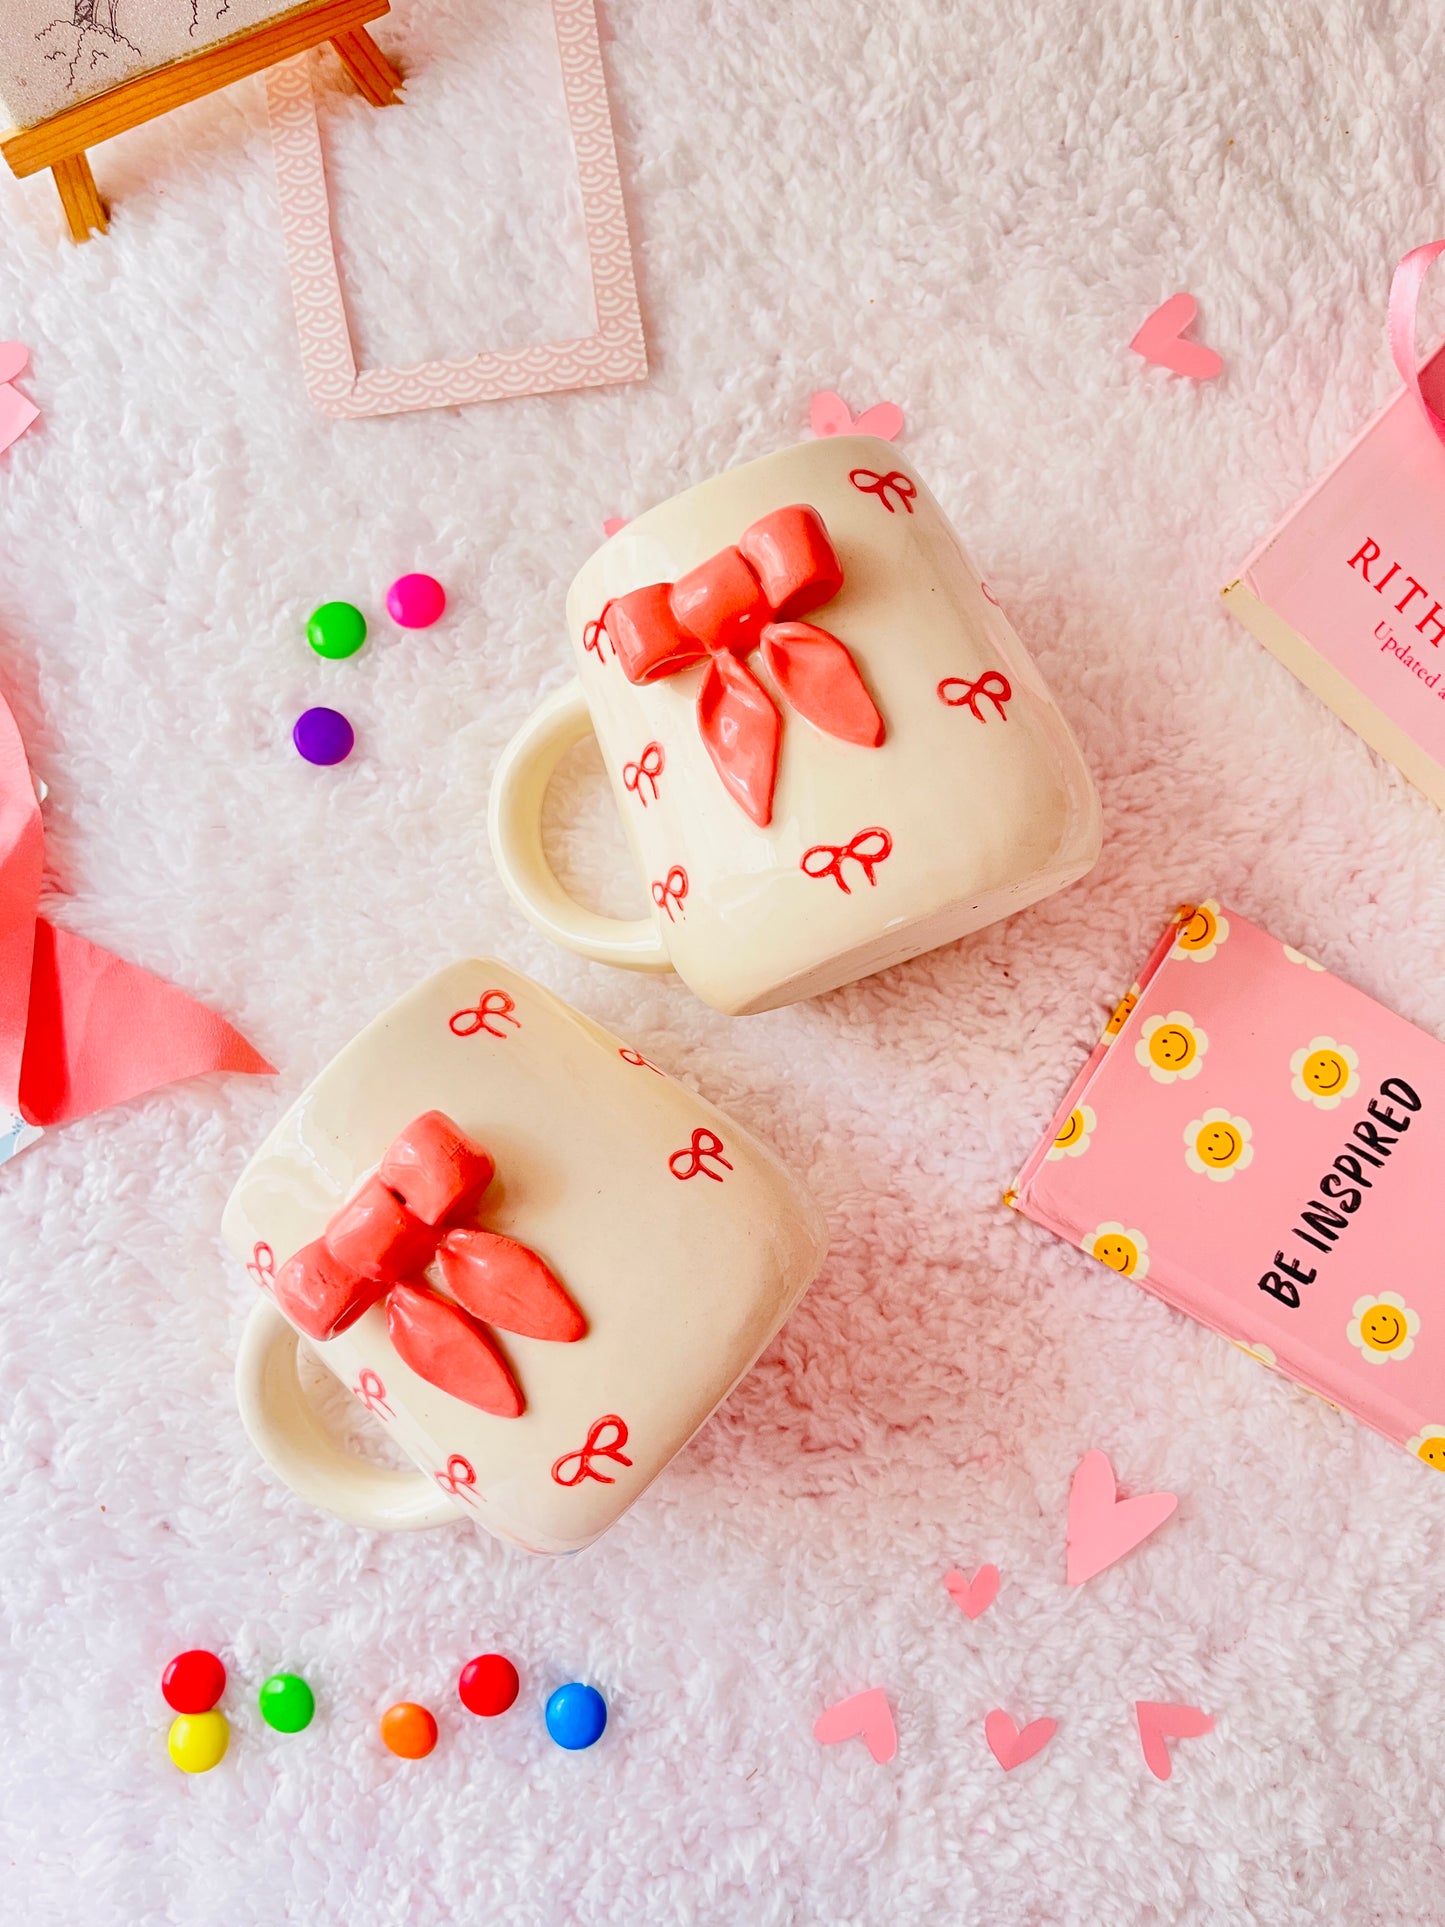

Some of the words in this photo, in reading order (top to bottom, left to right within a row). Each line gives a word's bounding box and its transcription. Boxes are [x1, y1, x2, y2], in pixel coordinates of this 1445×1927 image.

[1346, 536, 1445, 648] RITH
[1373, 620, 1442, 689] Updated
[1257, 1249, 1317, 1309] BE
[1291, 1077, 1422, 1254] INSPIRED
